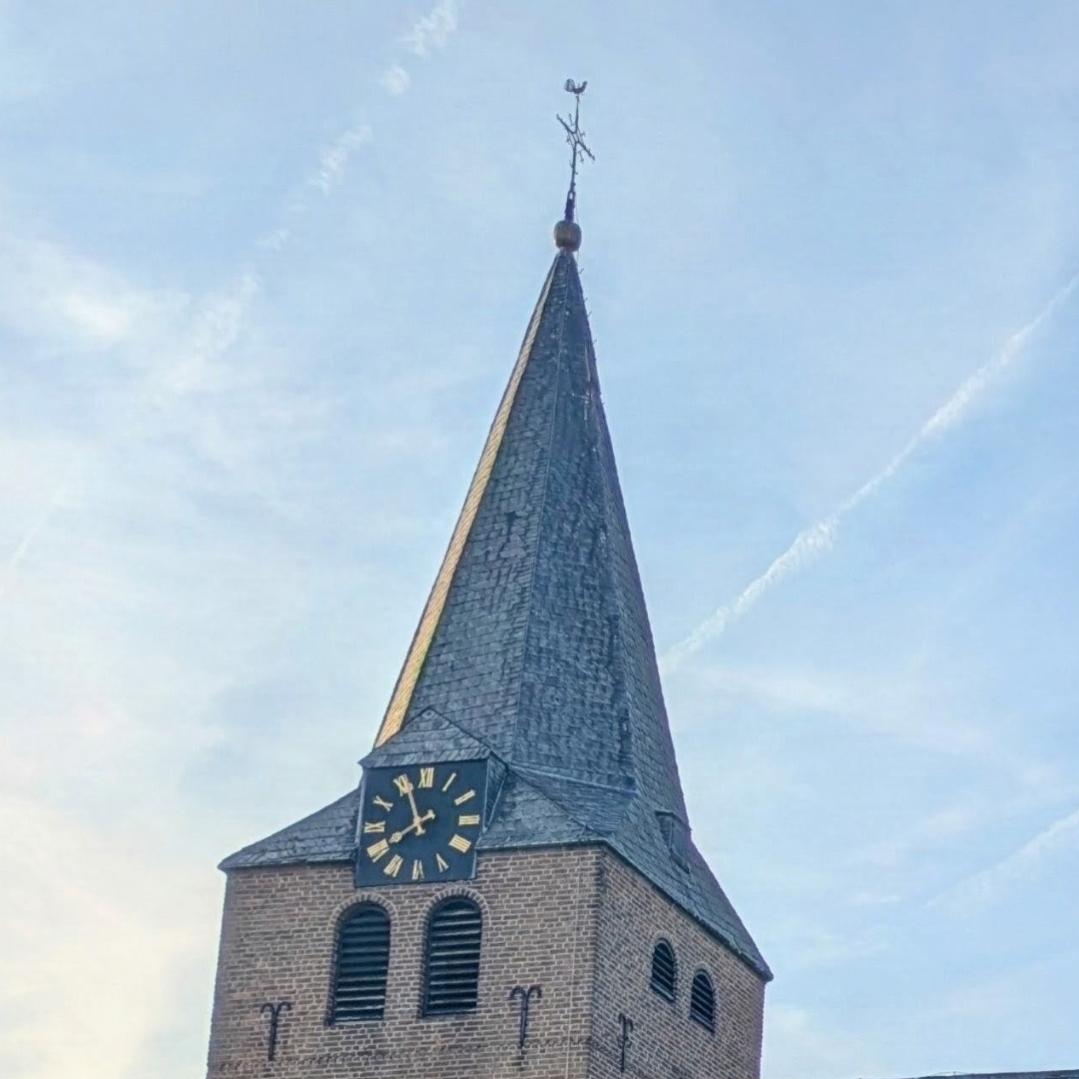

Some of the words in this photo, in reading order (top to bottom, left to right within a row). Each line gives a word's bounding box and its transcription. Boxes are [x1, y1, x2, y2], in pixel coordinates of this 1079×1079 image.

[417, 766, 435, 789] XII
[442, 772, 457, 792] I
[373, 795, 394, 812] X
[454, 789, 476, 806] II
[363, 820, 386, 834] IX
[411, 859, 425, 881] VI
[435, 852, 450, 873] V
